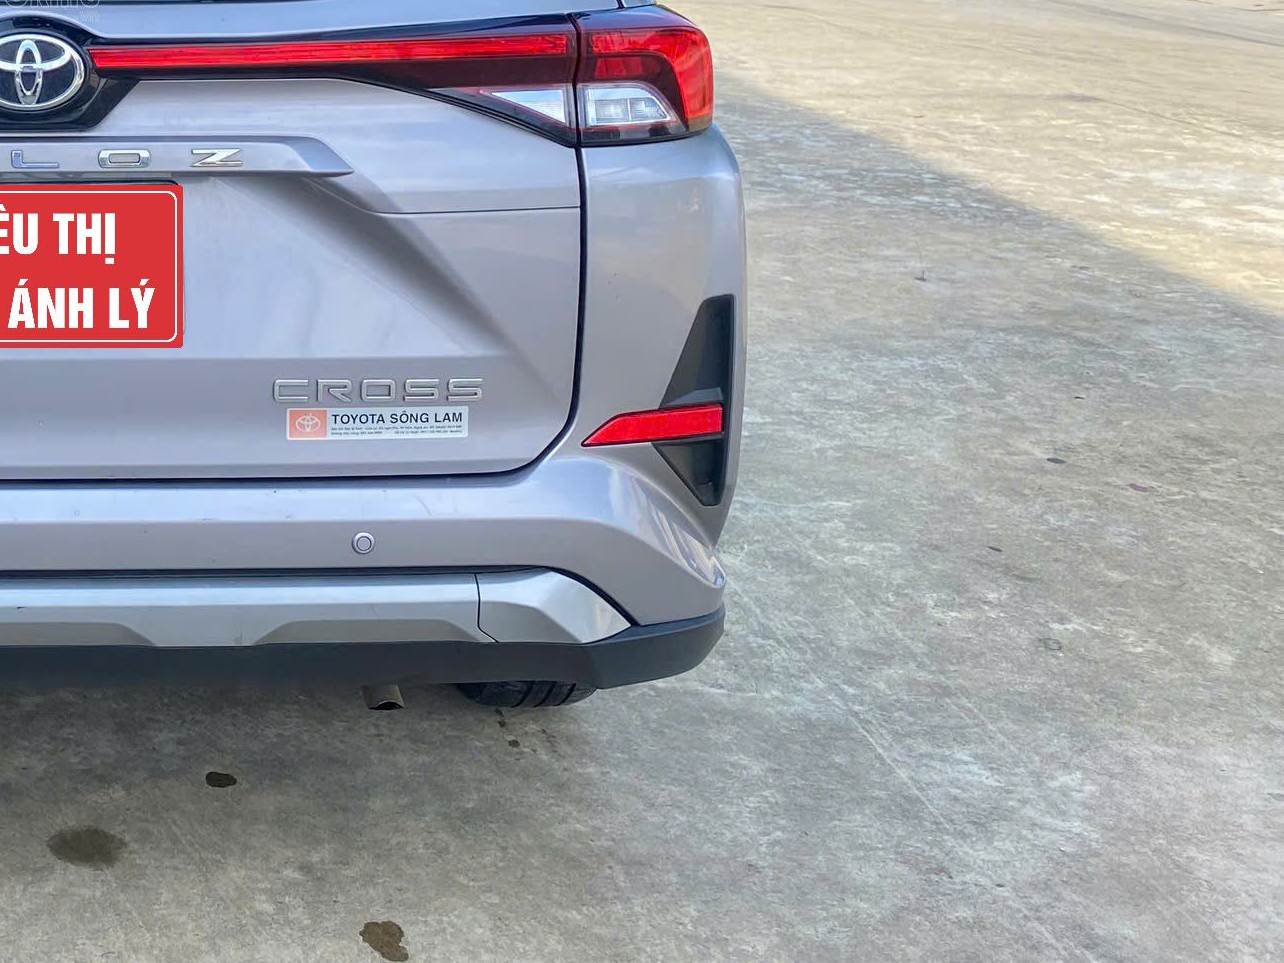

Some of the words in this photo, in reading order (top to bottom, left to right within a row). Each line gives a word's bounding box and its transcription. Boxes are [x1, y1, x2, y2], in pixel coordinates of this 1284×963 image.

[272, 378, 484, 403] CROSS
[331, 413, 385, 425] TOYOTA
[389, 410, 429, 424] SÔNG
[434, 412, 463, 423] LAM
